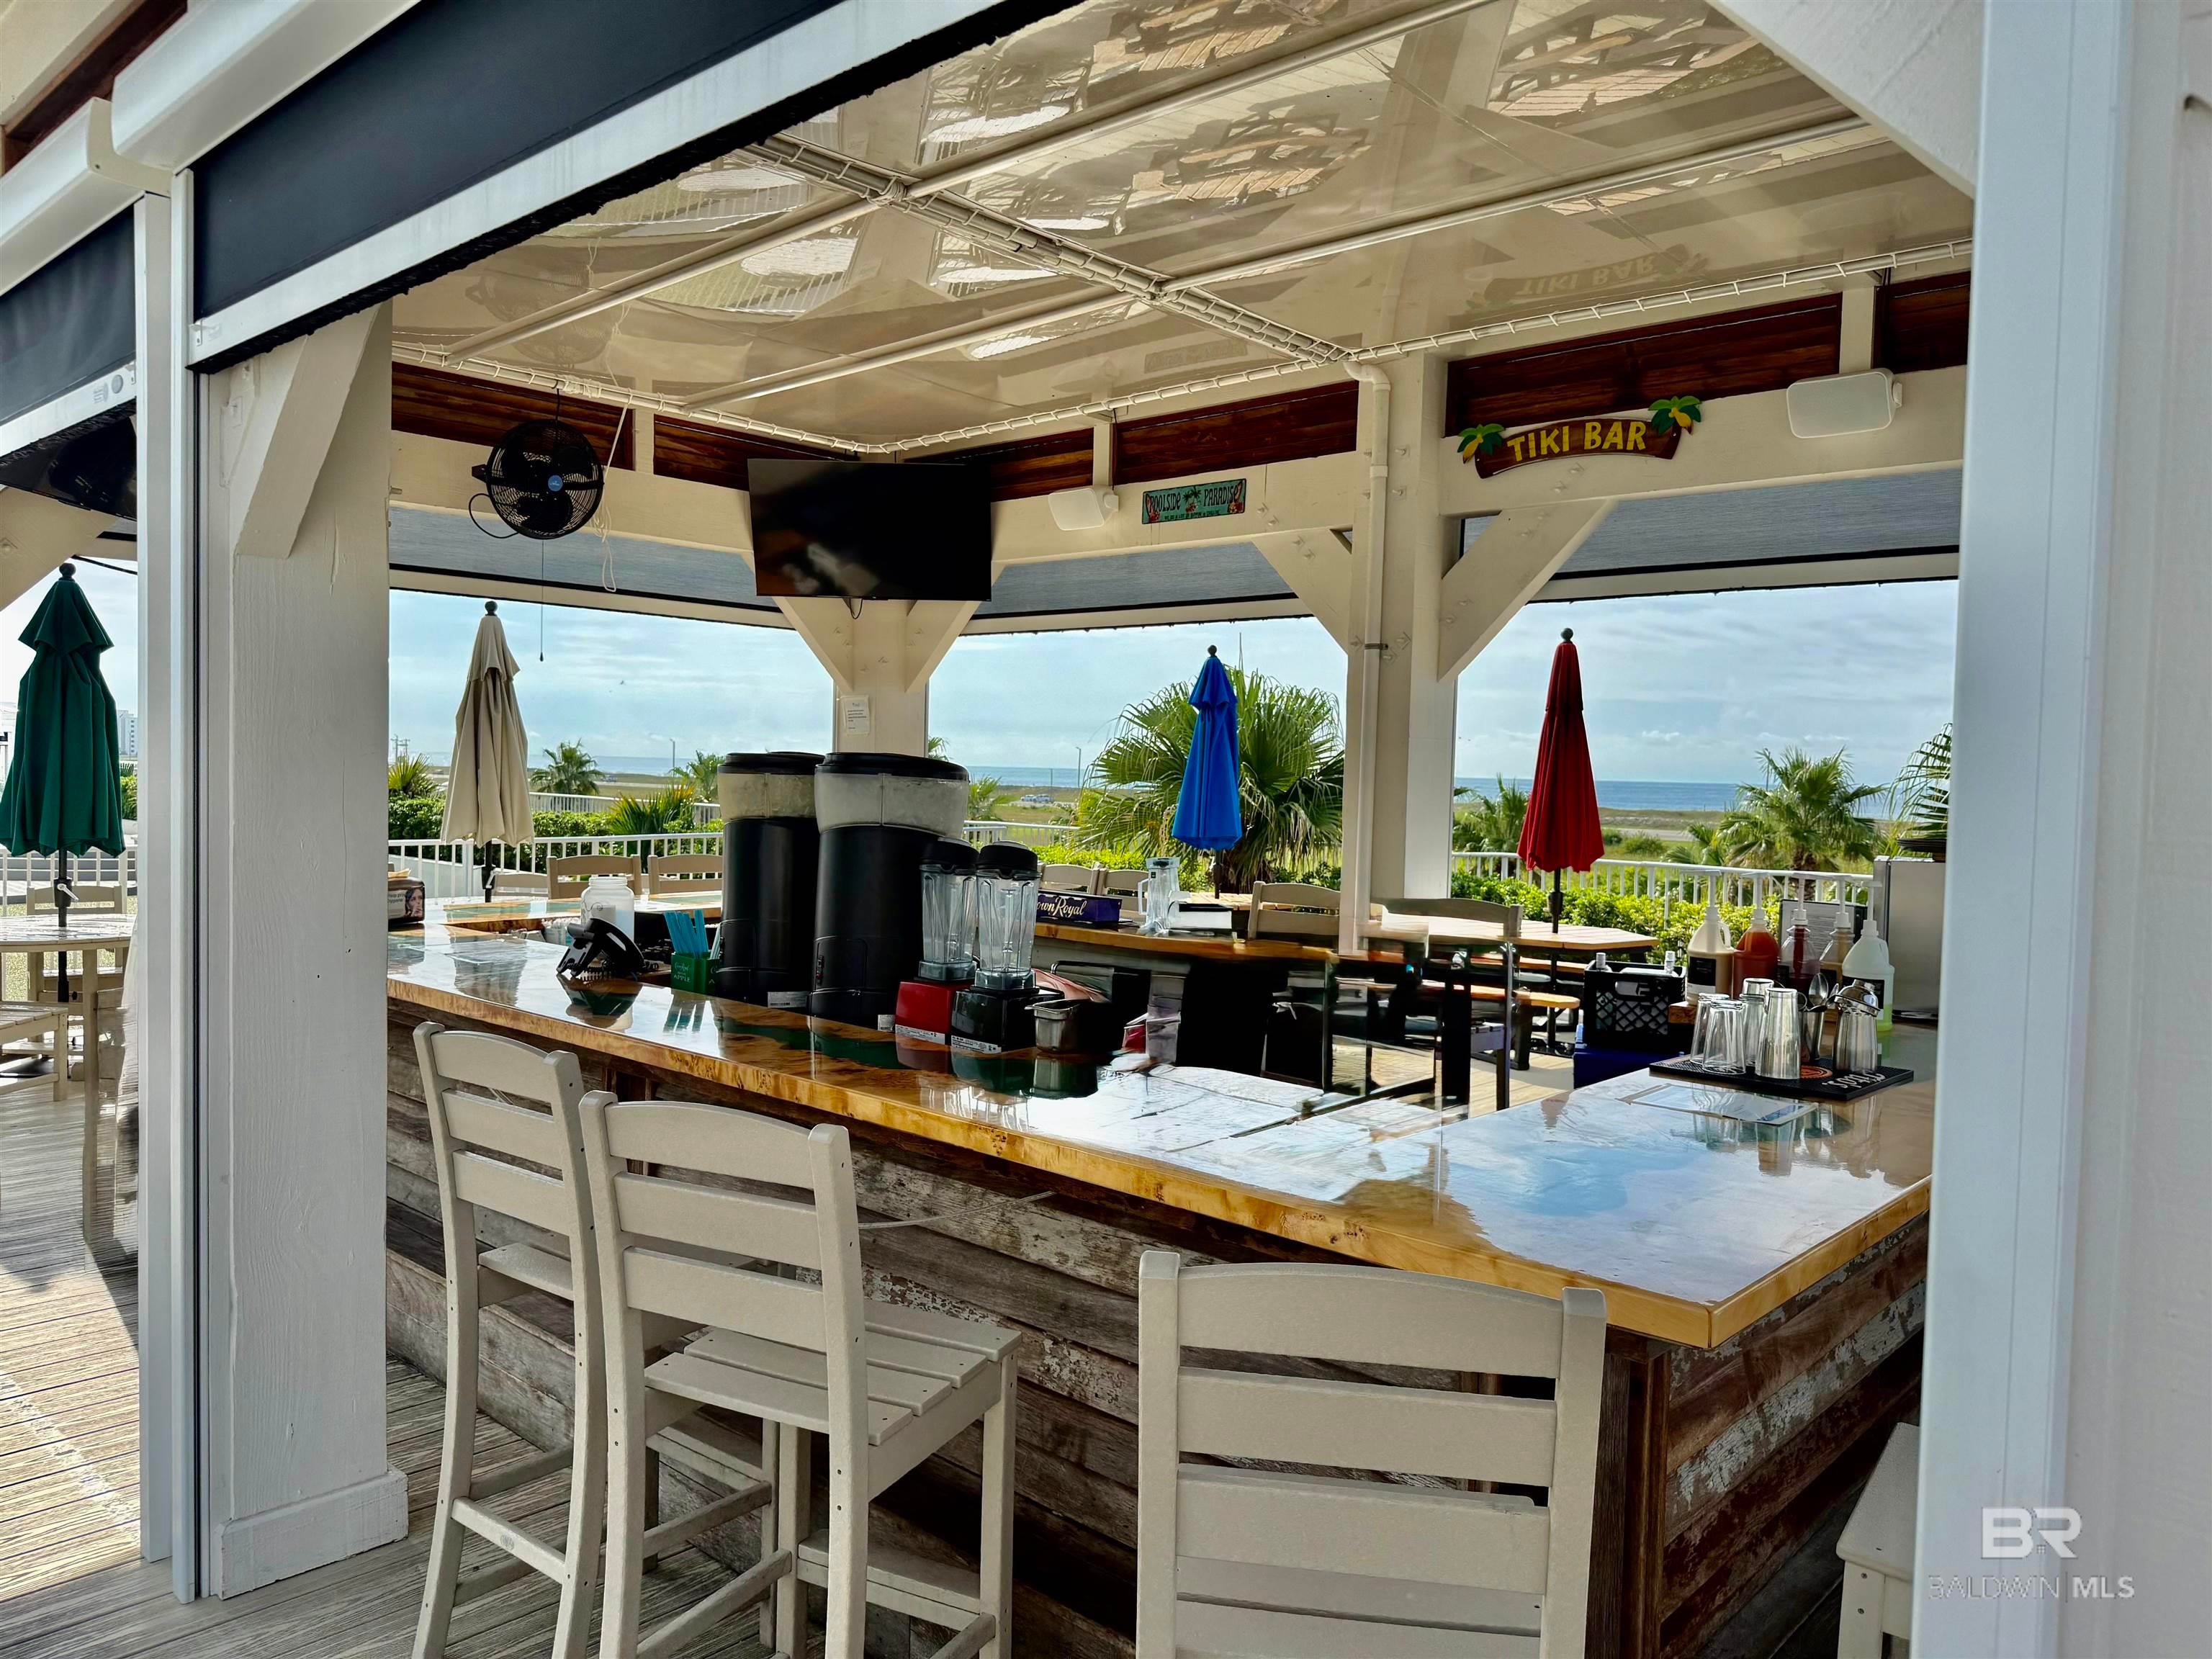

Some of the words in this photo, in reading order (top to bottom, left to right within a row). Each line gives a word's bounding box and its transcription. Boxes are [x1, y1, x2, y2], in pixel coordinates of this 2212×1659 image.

[1507, 426, 1570, 462] TIKI
[1584, 421, 1647, 451] BAR
[1037, 902, 1055, 912] own
[1052, 896, 1087, 918] Royal
